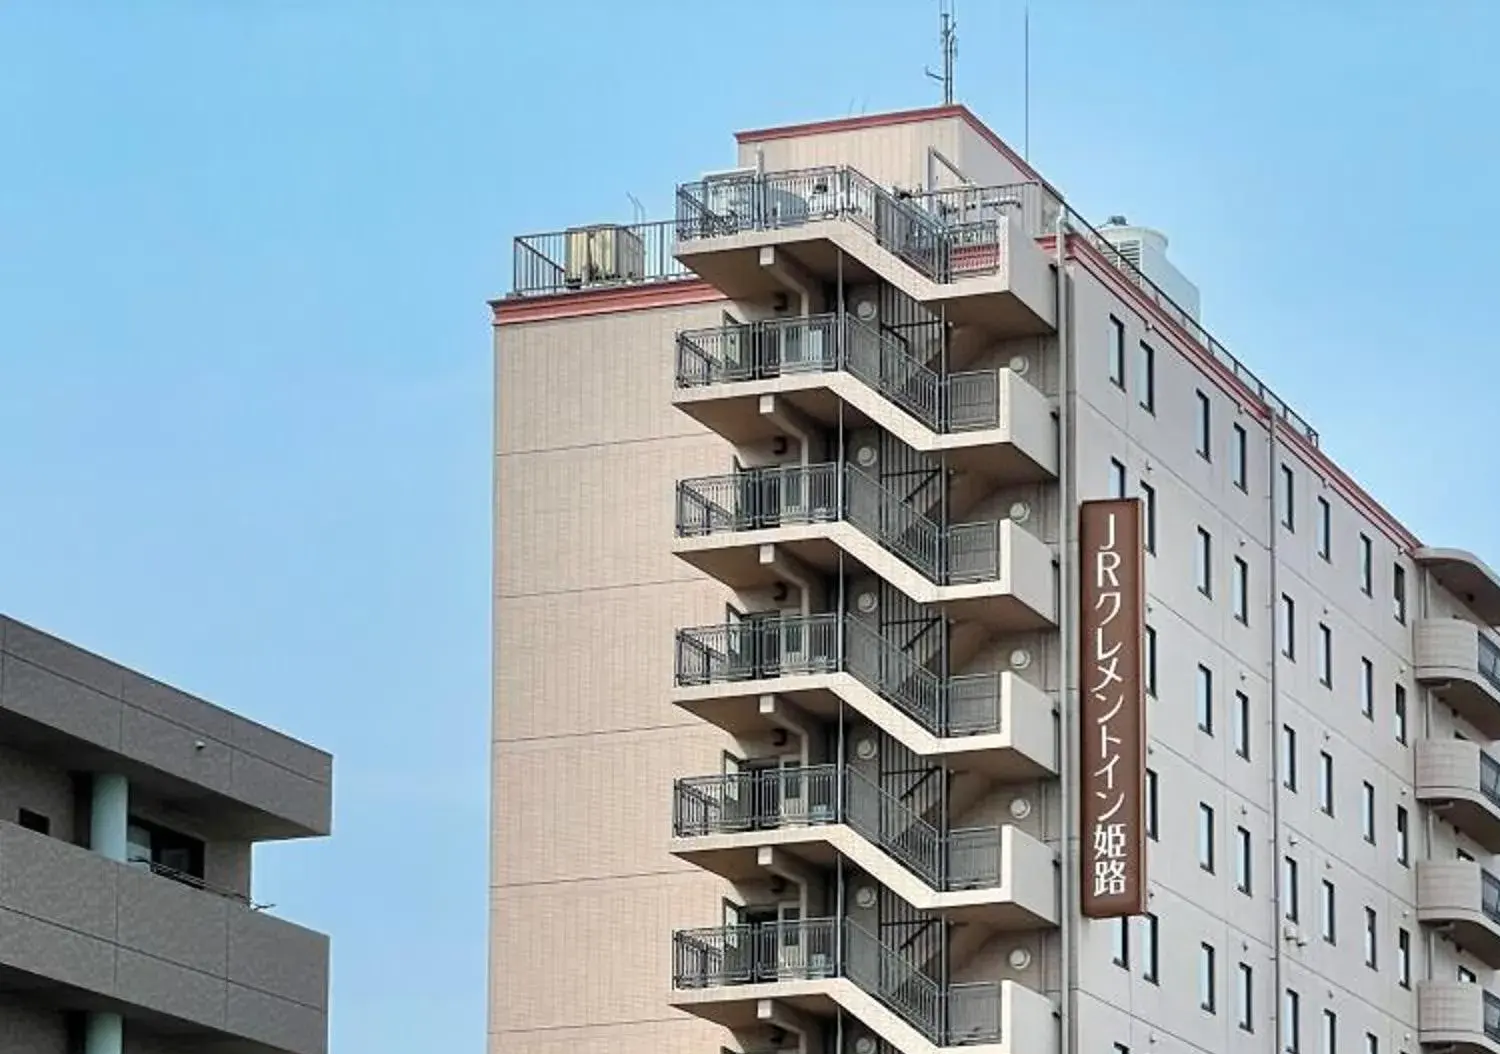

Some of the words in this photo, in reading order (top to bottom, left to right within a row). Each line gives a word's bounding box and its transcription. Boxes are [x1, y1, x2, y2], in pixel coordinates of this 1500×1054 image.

[1093, 513, 1127, 897] JRクレメントイン姫路
